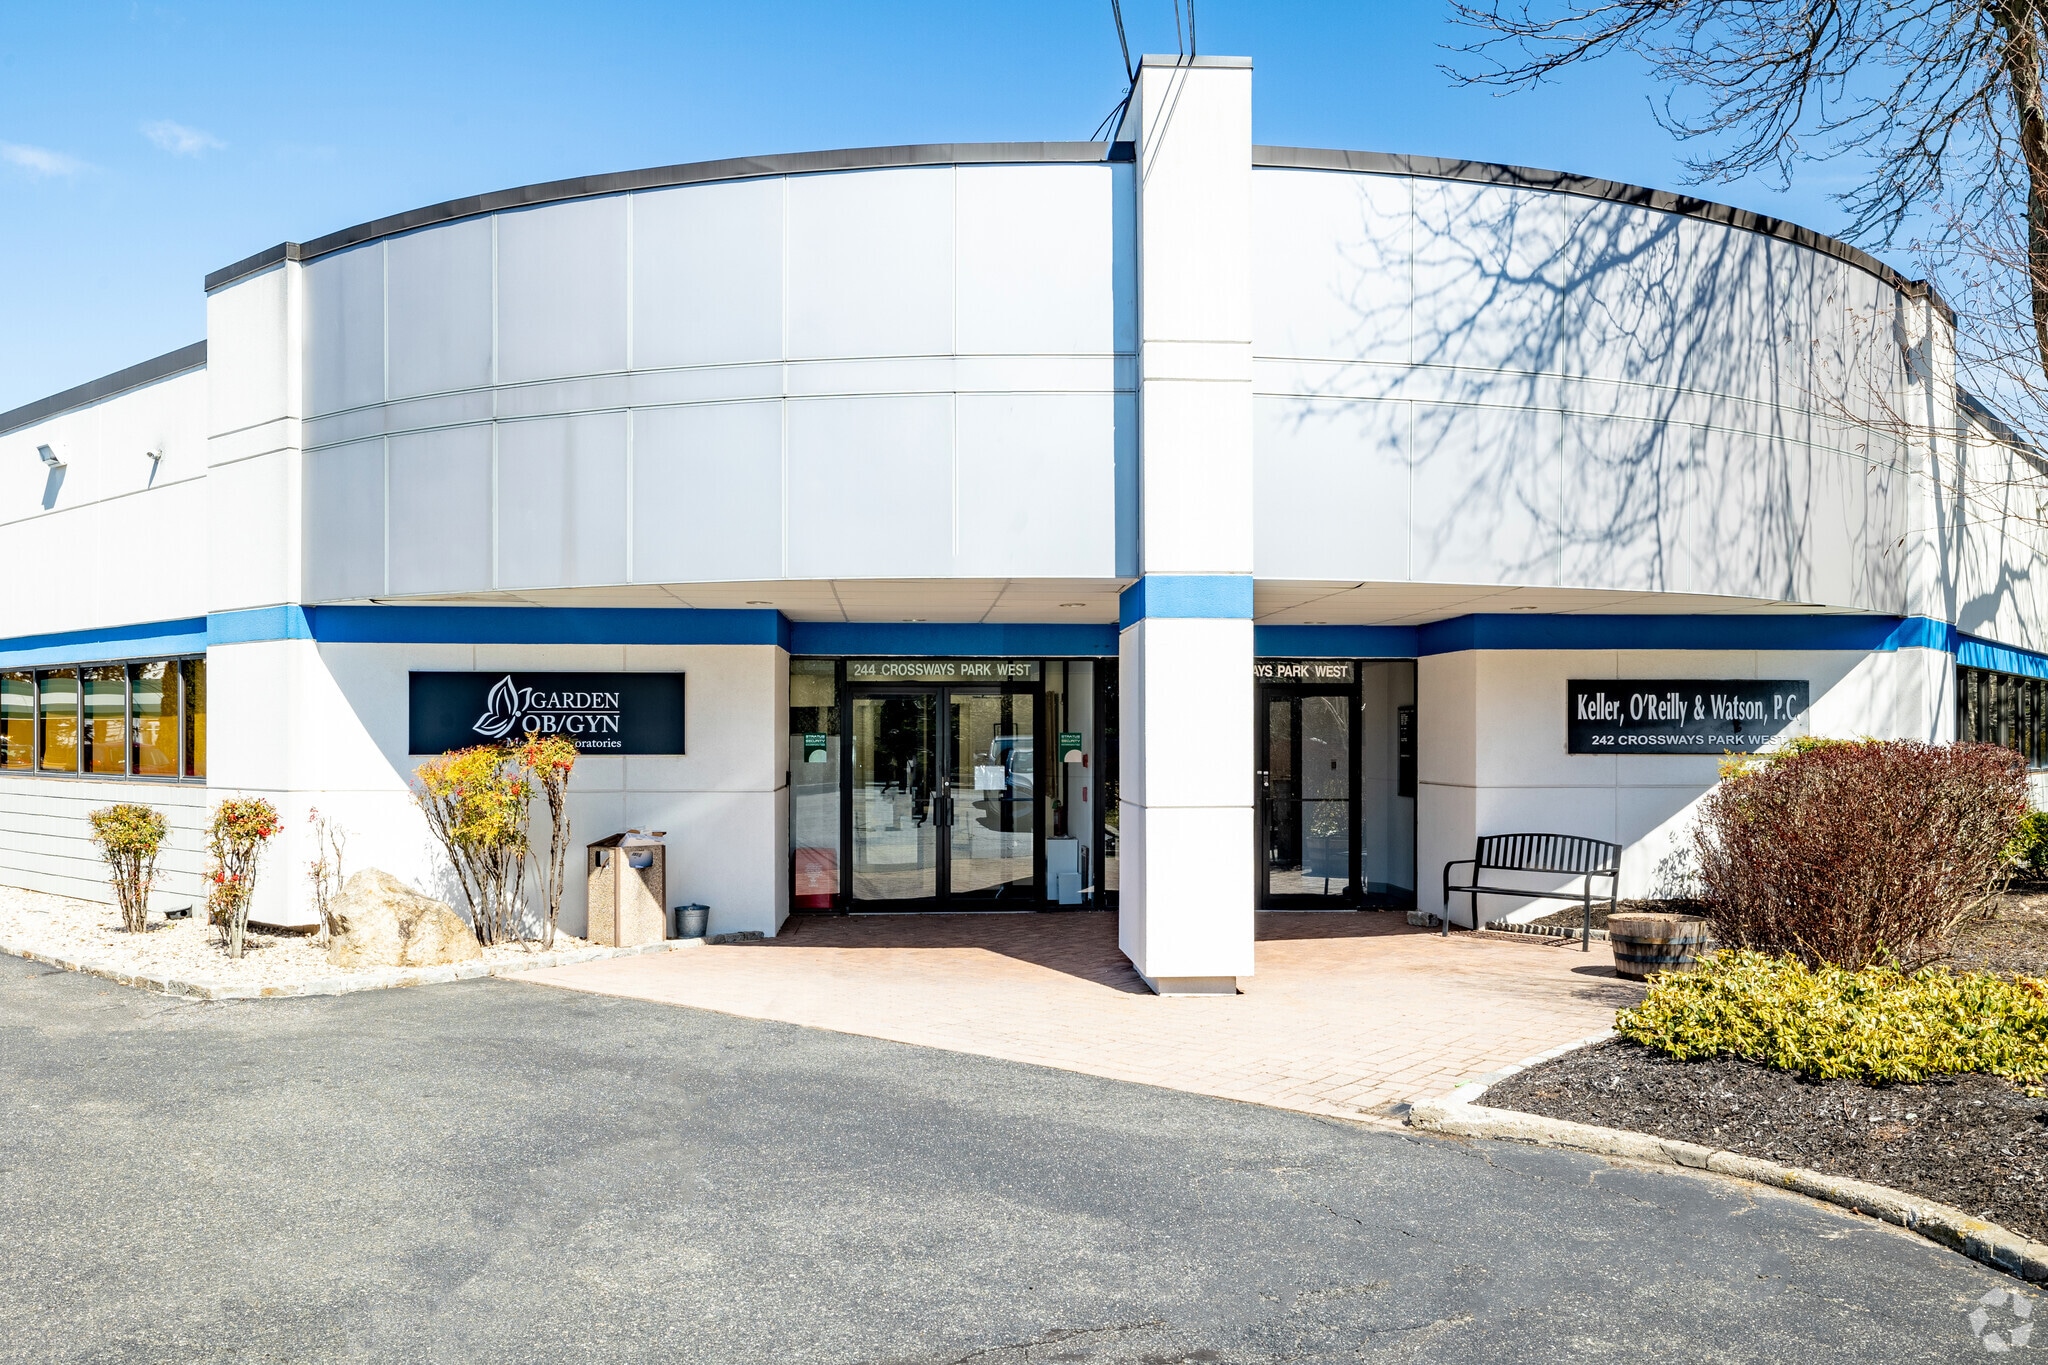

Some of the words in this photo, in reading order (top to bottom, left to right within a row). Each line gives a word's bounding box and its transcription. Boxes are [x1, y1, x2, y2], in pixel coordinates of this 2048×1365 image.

[854, 663, 876, 676] 244
[881, 663, 955, 676] CROSSWAYS
[961, 663, 992, 676] PARK
[997, 663, 1031, 676] WEST
[1277, 665, 1310, 677] PARK
[1315, 665, 1348, 677] WEST
[531, 692, 620, 709] GARDEN
[1577, 692, 1624, 727] Keller,
[1629, 692, 1688, 728] O'Reilly
[1693, 694, 1705, 721] &
[1710, 694, 1768, 727] Watson,
[521, 714, 620, 733] OB/GYN
[1591, 735, 1615, 746] 242
[1618, 735, 1704, 746] CROSSWAYS
[1708, 735, 1744, 746] PARK
[1748, 735, 1787, 746] WEST
